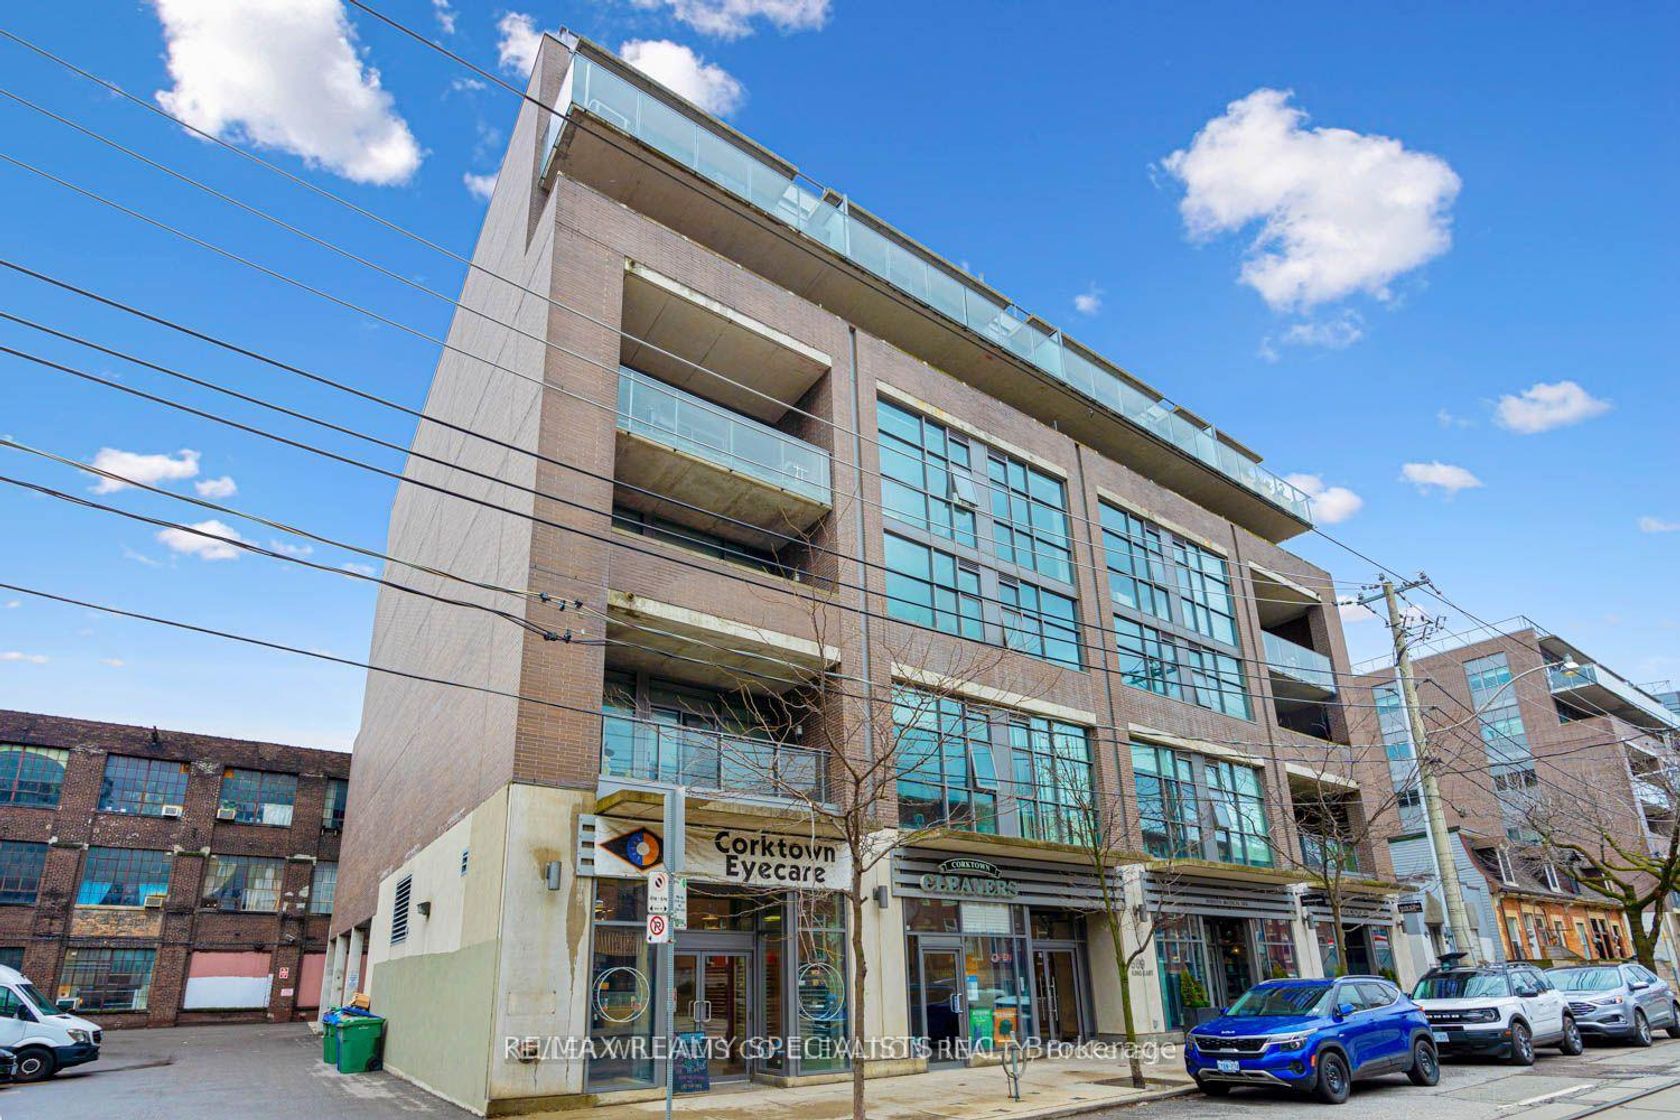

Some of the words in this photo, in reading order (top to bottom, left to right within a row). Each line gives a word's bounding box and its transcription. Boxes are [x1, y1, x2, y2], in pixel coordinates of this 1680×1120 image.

[714, 831, 836, 862] Corktown
[725, 854, 826, 883] Eyecare
[951, 861, 991, 871] CORKTOWN
[920, 873, 1018, 898] CLEANERS
